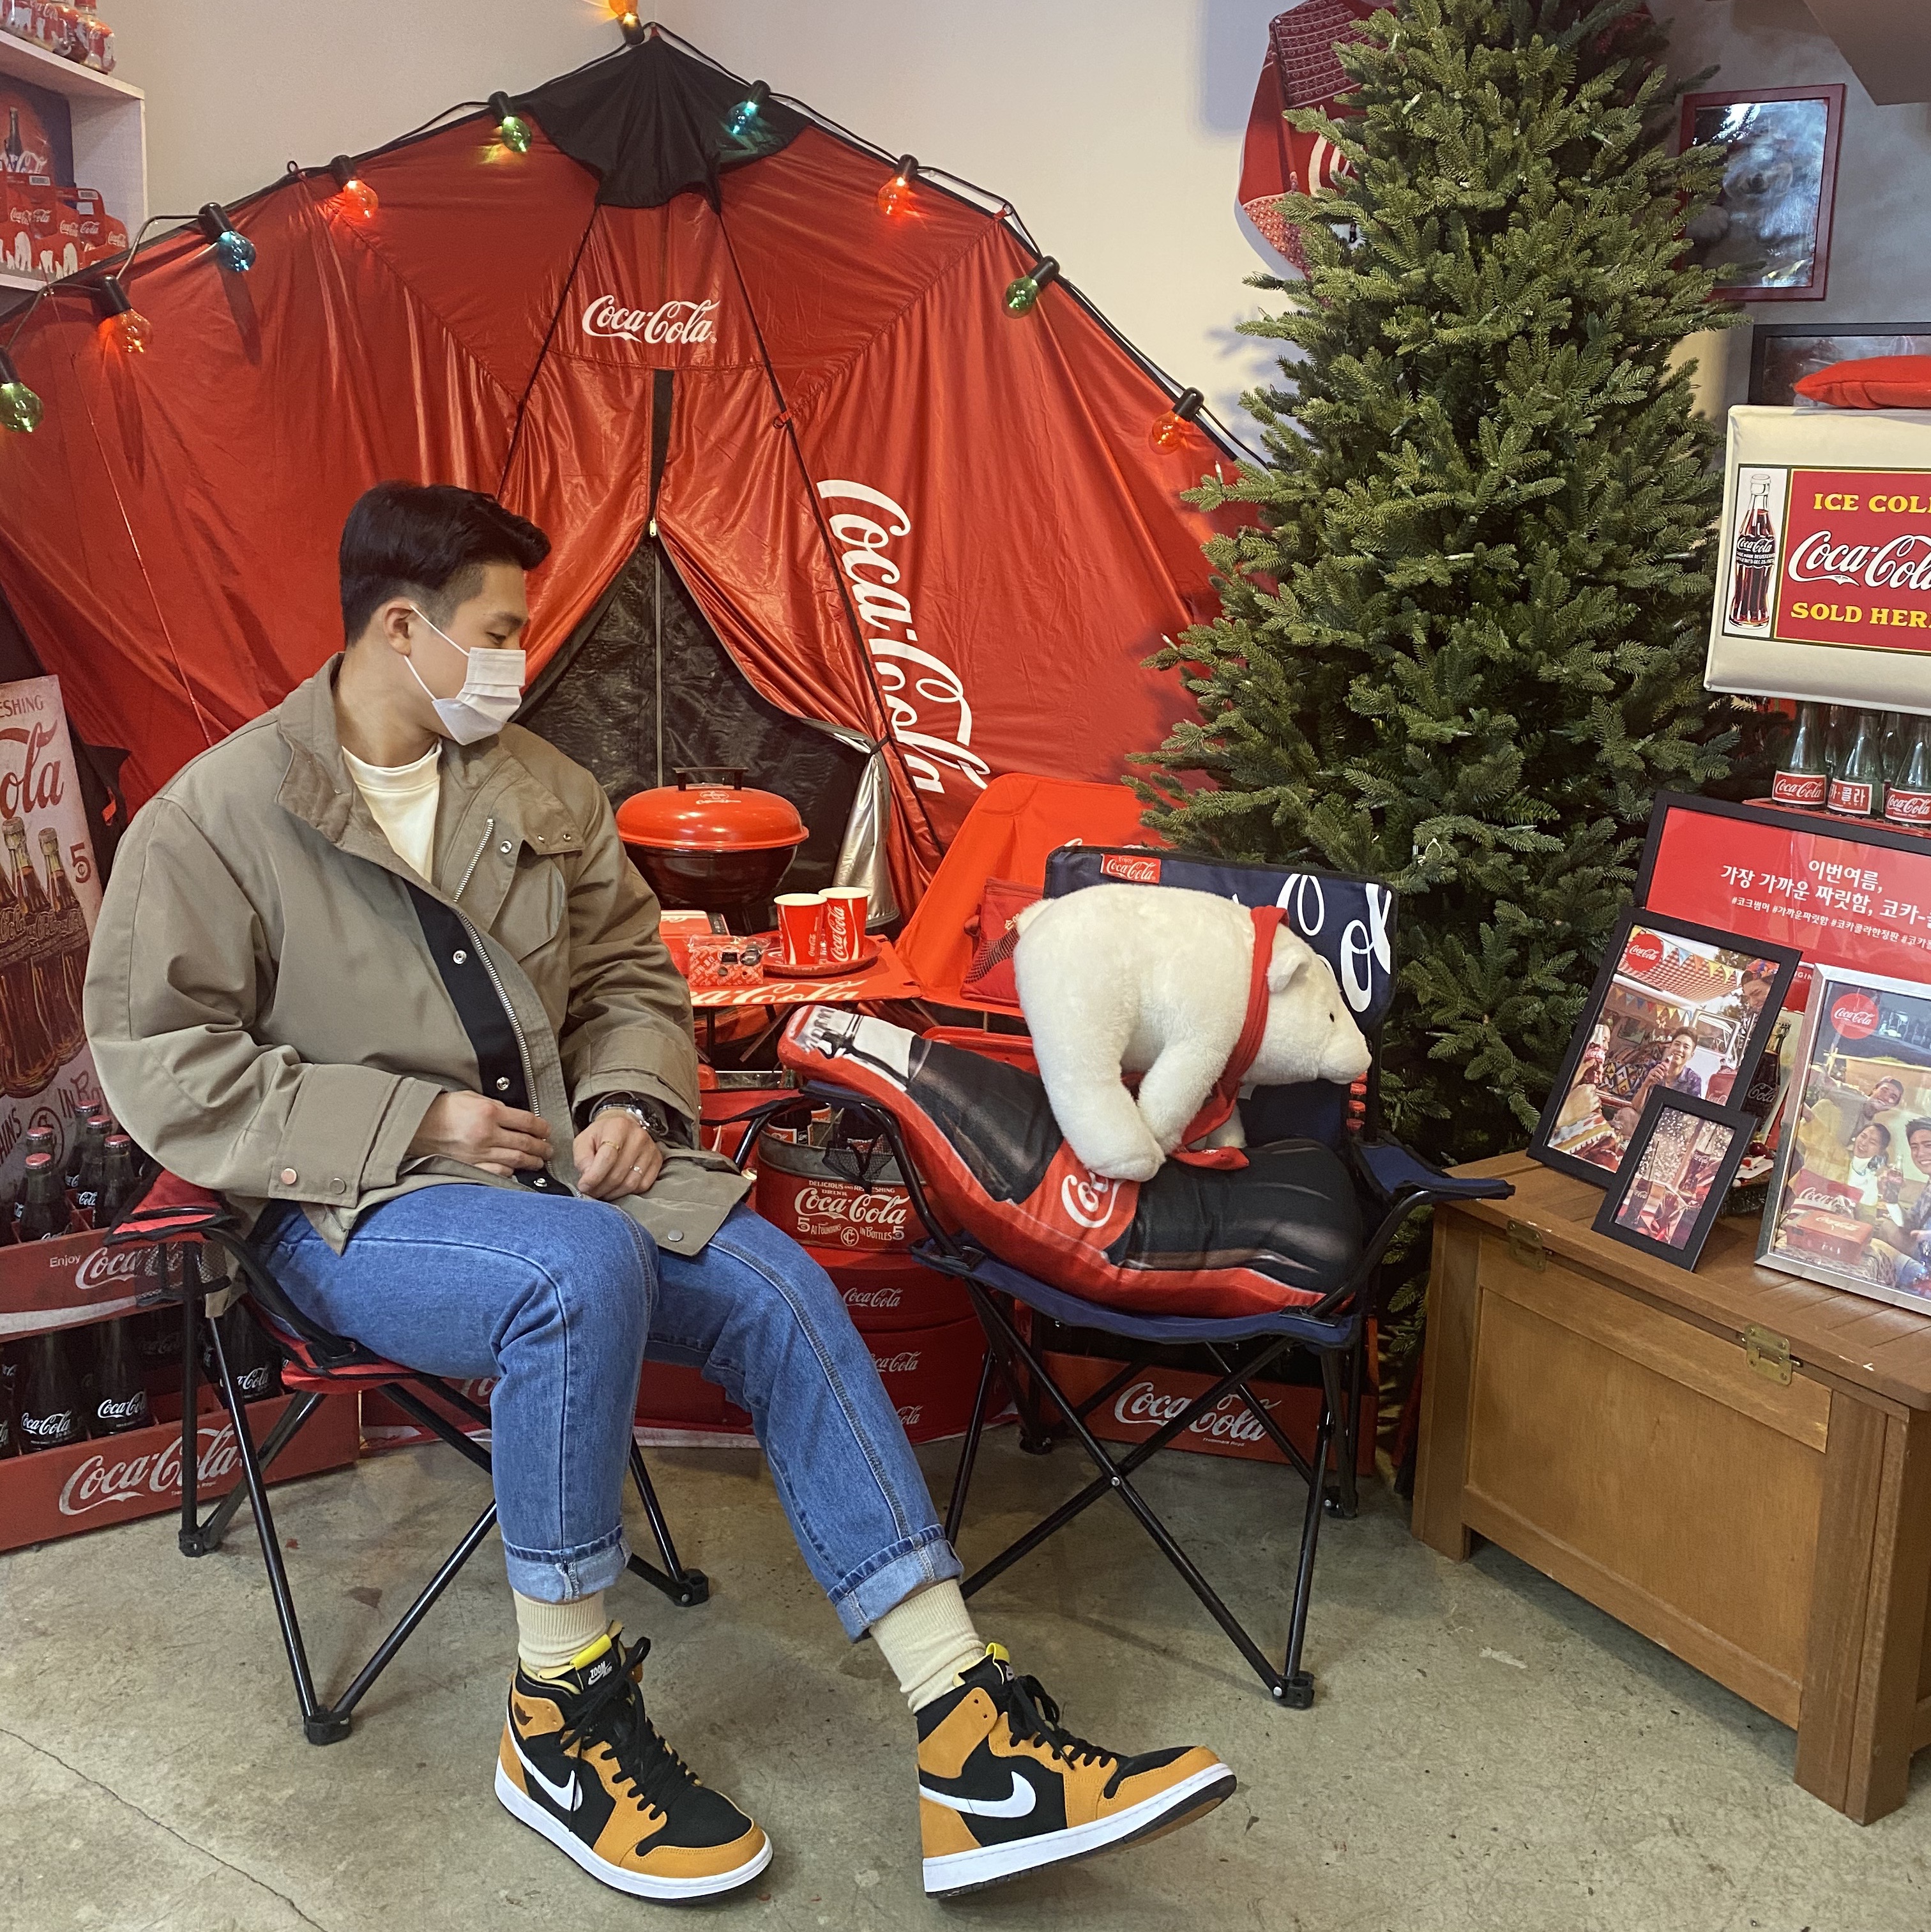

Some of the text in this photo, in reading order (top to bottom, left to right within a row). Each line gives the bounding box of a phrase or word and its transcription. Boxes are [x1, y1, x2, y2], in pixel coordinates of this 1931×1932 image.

[582, 294, 721, 344] Coca-Cola
[1813, 493, 1931, 513] ICE COL
[1738, 537, 1775, 553] Coca-Cola
[1788, 530, 1931, 591] Coca-Col
[1791, 602, 1931, 628] SOLD HER
[1775, 779, 1824, 798] Coca-Cola
[1106, 858, 1156, 880] Coca-Cola
[1118, 856, 1133, 864] Enjoy
[1808, 860, 1883, 894] 이번여름,
[1720, 865, 1755, 888] 가장
[1758, 872, 1810, 901] 가까운
[1815, 885, 1874, 917] 짜릿함,
[1834, 1007, 1876, 1026] Coca-Cola
[808, 1180, 844, 1190] DELICIOUS
[794, 1187, 911, 1224] Coca-Cola
[49, 1254, 82, 1268] Enjoy
[843, 1288, 903, 1307] Coca-Cola
